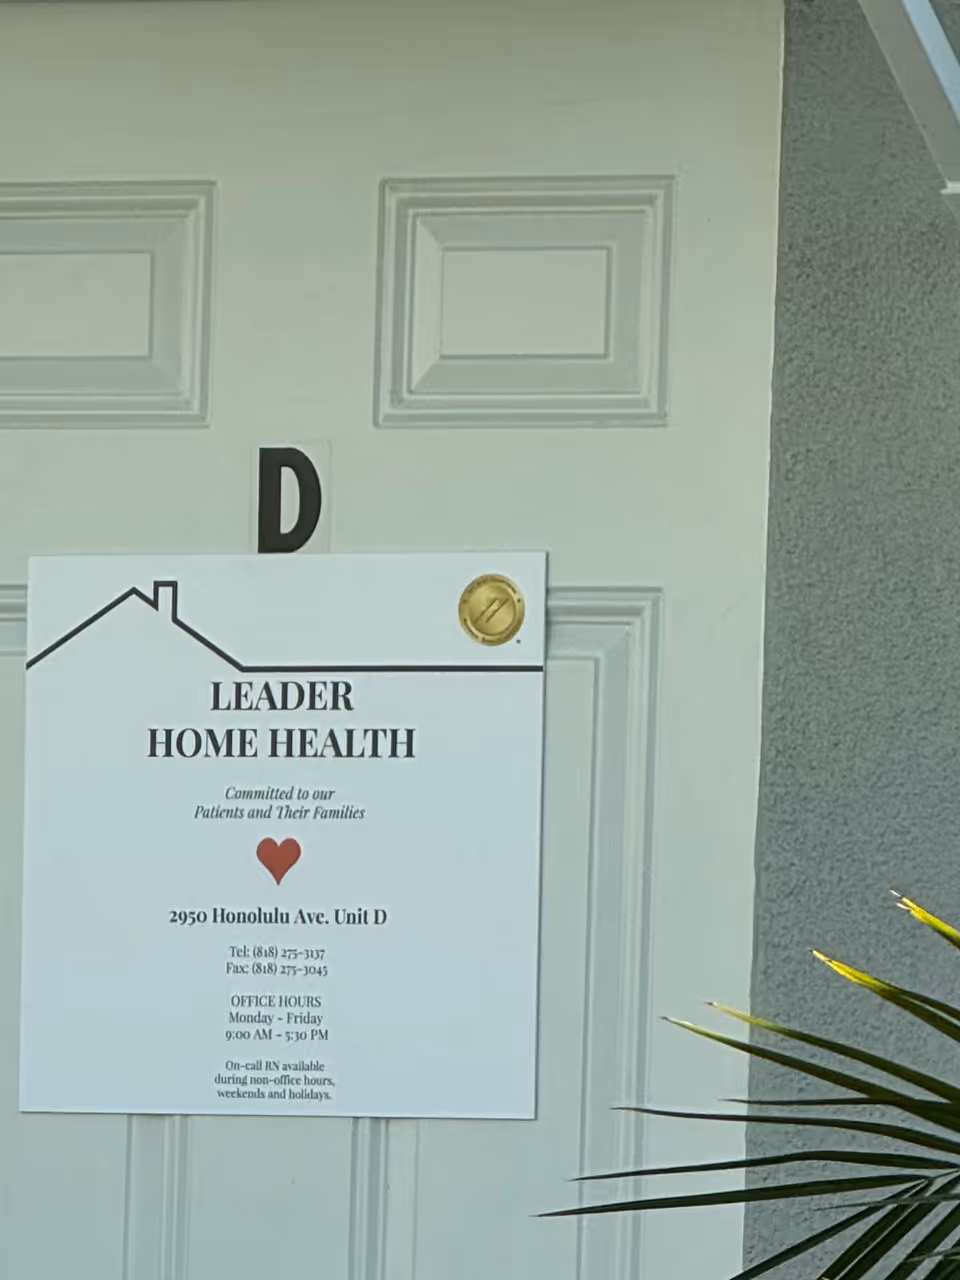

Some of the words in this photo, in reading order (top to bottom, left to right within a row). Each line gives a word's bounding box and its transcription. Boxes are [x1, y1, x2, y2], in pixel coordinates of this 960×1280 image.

[258, 448, 322, 553] D
[211, 681, 354, 711] LEADER
[147, 728, 258, 758] HOME
[268, 728, 416, 758] HEALTH
[225, 786, 294, 801] Committed
[297, 788, 309, 801] to
[312, 789, 335, 801] our
[194, 805, 244, 819] Patients
[247, 805, 272, 819] and
[276, 805, 310, 820] Their
[313, 805, 365, 820] Families
[169, 910, 207, 926] 2950
[212, 907, 289, 924] Honolulu
[294, 909, 329, 924] Ave.
[334, 909, 369, 925] Unit
[372, 909, 387, 925] D
[229, 946, 250, 958] Tel:
[253, 946, 278, 959] (818)
[281, 948, 325, 960] 275-3137
[226, 962, 249, 974] Fax:
[252, 962, 277, 975] (818)
[280, 964, 327, 976] 275-3045
[231, 995, 275, 1007] OFFICE
[279, 996, 321, 1008] HOURS
[229, 1012, 274, 1025] Monday
[286, 1013, 323, 1025] Friday
[225, 1030, 250, 1041] 9:00
[253, 1029, 272, 1040] AM
[285, 1030, 308, 1042] 5:30
[310, 1029, 328, 1040] PM
[225, 1060, 262, 1071] On-call
[265, 1061, 279, 1071] RN
[282, 1061, 324, 1071] available
[215, 1075, 247, 1086] during
[250, 1075, 301, 1085] non-office
[304, 1075, 335, 1087] hours,
[217, 1089, 265, 1099] weekends
[268, 1089, 286, 1099] and
[289, 1089, 332, 1101] holidays.
